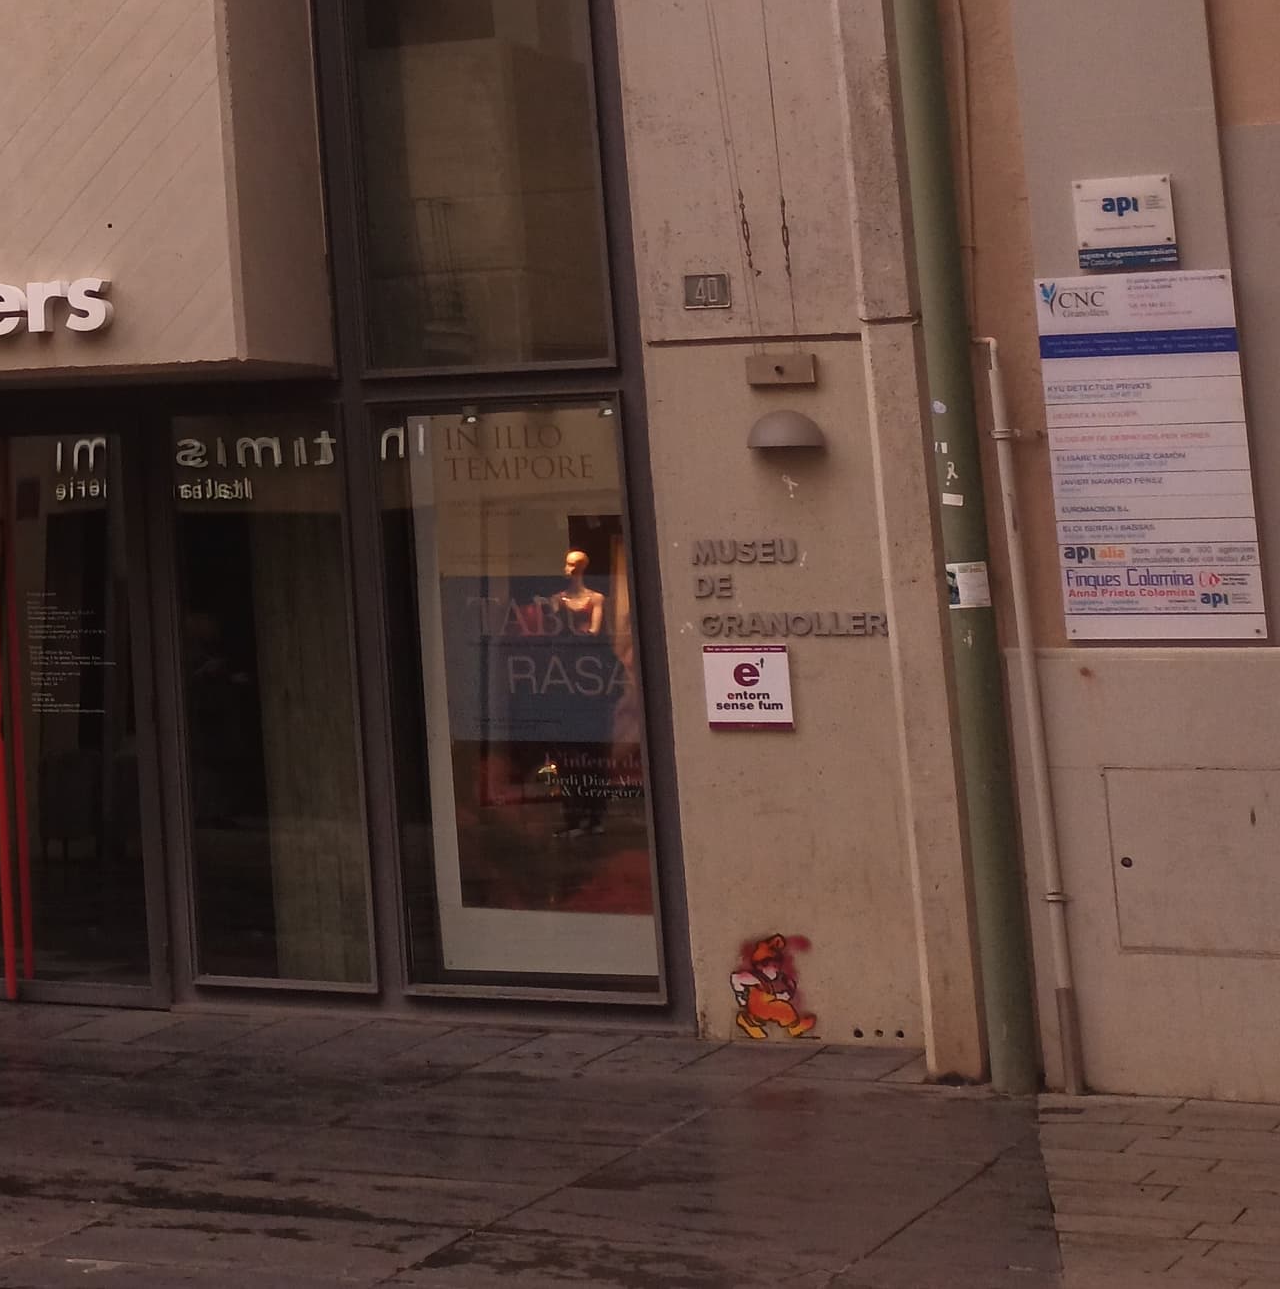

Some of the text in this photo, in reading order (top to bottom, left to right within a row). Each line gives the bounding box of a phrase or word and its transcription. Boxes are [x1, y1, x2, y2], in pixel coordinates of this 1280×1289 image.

[1101, 196, 1139, 217] api
[695, 277, 719, 302] 40
[1058, 290, 1106, 309] CNC
[445, 424, 563, 450] IN ILLO
[444, 454, 594, 481] TEMPORE
[692, 539, 799, 566] MUSEU
[1064, 546, 1096, 564] api
[695, 574, 734, 599] DE
[1066, 568, 1121, 590] Finques
[1126, 567, 1194, 587] Colomina
[1068, 588, 1196, 598] Anna Prieto Colomina
[1200, 592, 1229, 608] api
[508, 654, 638, 696] RASA
[716, 700, 784, 711] sense fum
[727, 690, 770, 701] entorn
